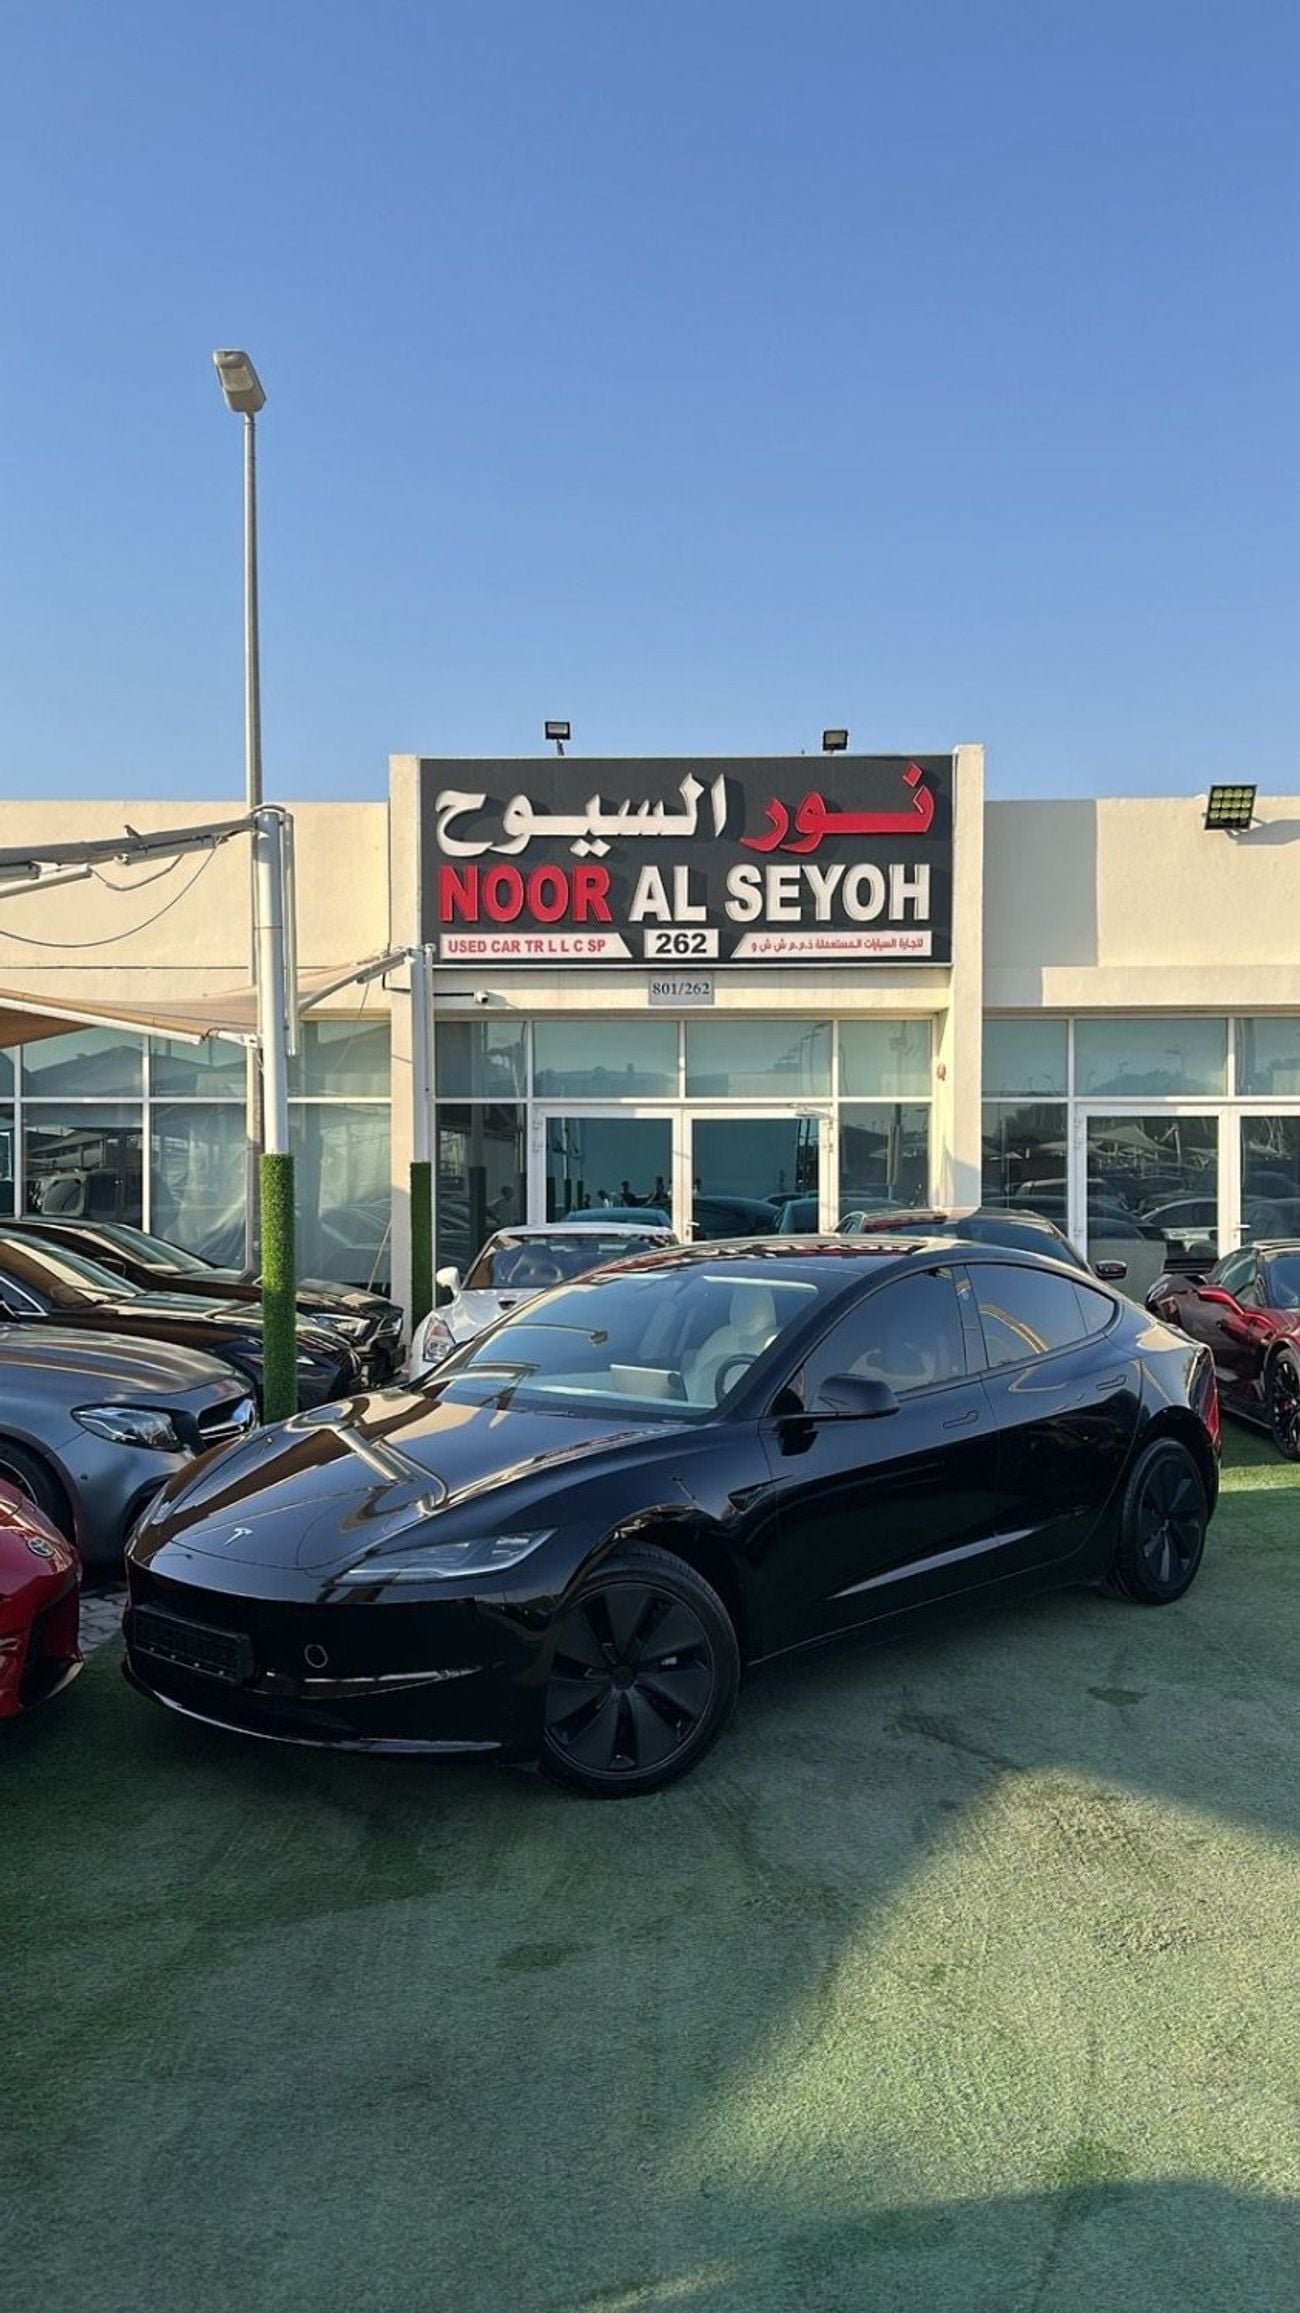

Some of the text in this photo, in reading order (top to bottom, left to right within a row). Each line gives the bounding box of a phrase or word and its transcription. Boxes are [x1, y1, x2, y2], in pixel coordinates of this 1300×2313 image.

[434, 762, 935, 858] نور السيوح
[438, 863, 931, 924] NOOR AL SEYOH
[448, 939, 606, 953] USED CAR TR L L C SP
[655, 933, 708, 954] 262
[652, 982, 710, 995] 801/262
